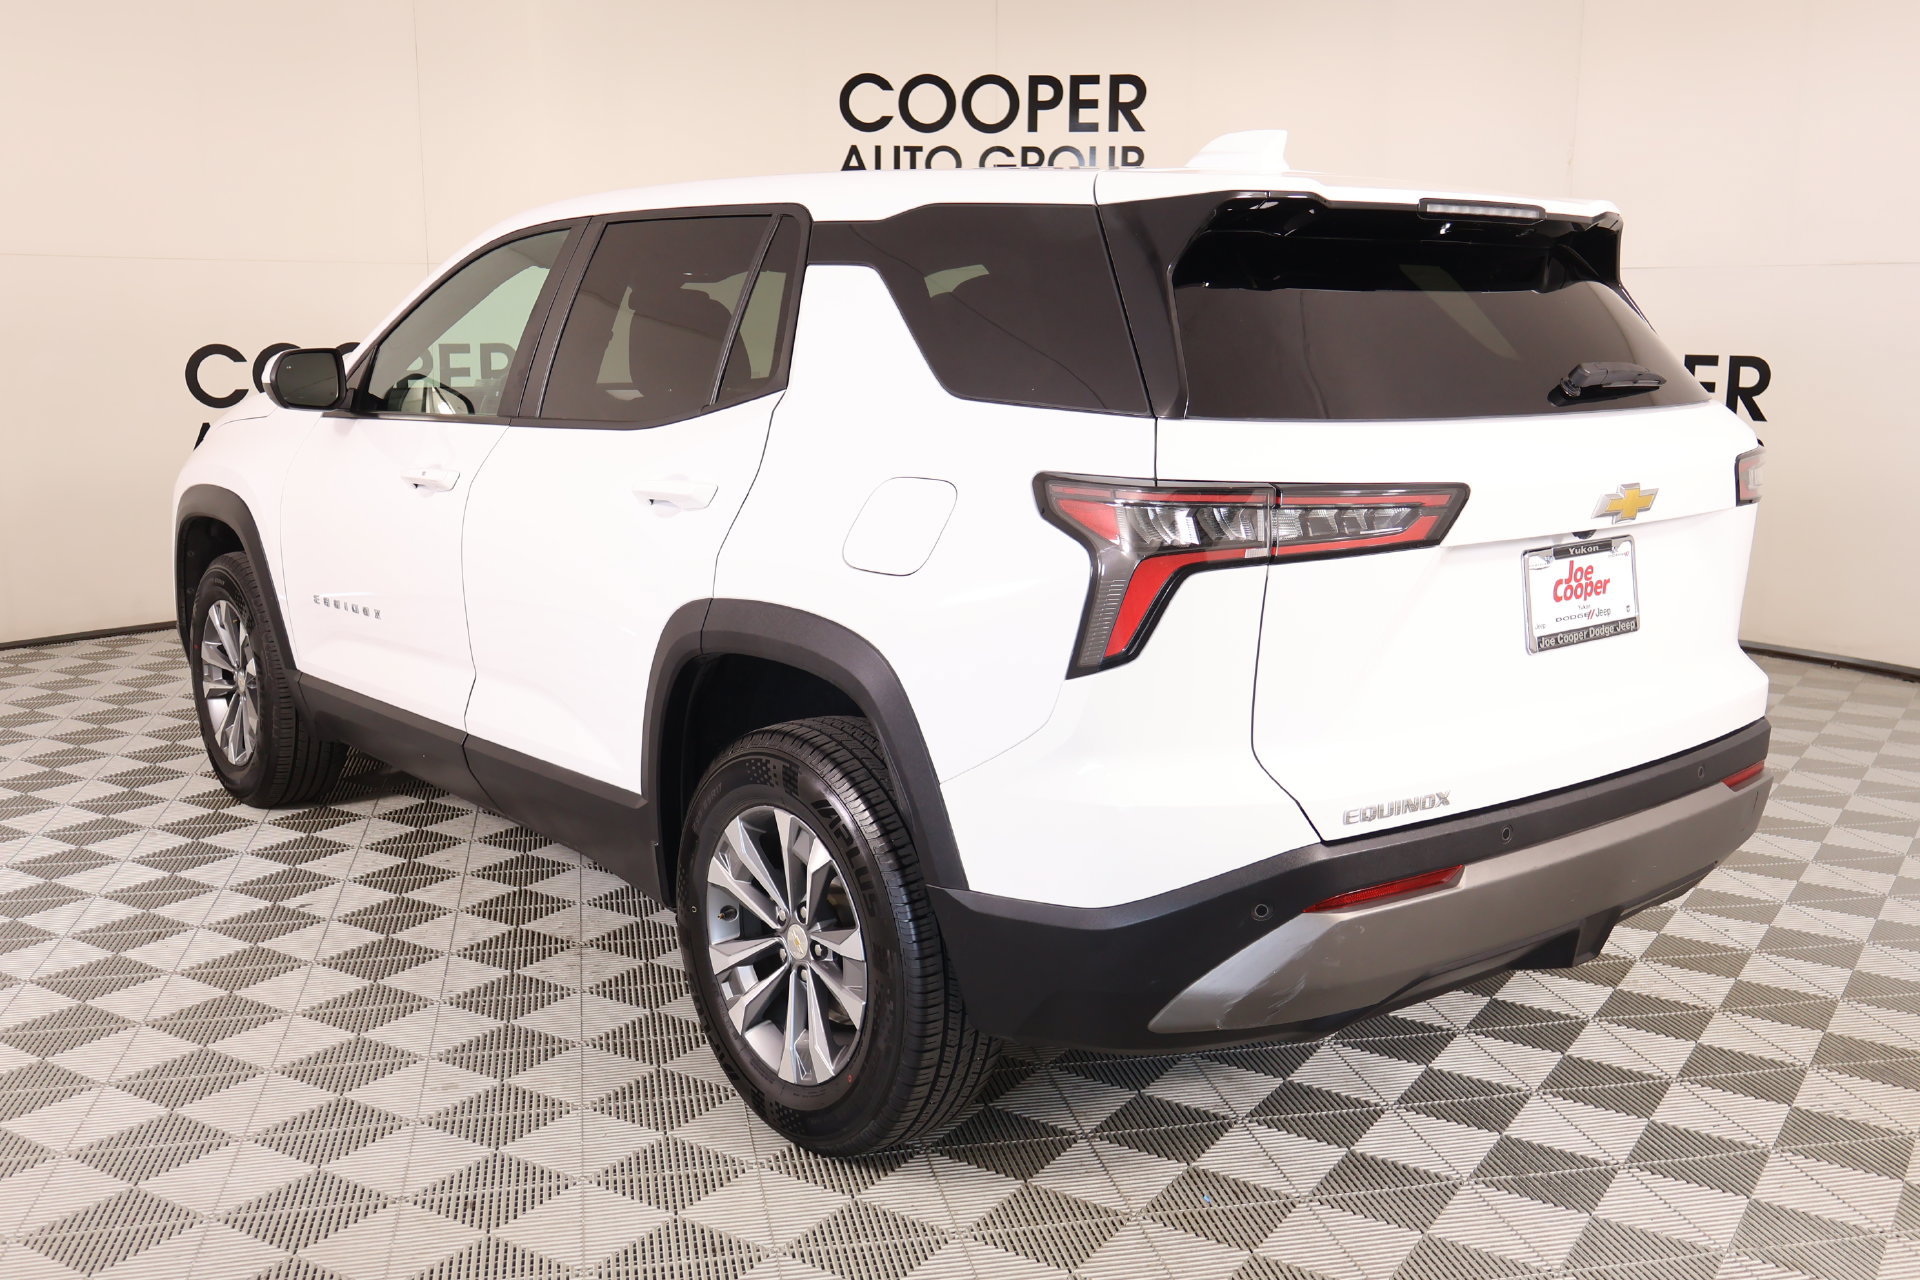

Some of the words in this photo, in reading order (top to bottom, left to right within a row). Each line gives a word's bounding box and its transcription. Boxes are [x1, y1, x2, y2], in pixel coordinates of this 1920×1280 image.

[839, 72, 1147, 134] COOPER
[841, 145, 963, 171] AUTO
[1568, 545, 1600, 556] Yukon
[1565, 560, 1594, 584] Joe
[1553, 578, 1610, 603] Cooper
[313, 594, 382, 620] EQUINOX
[1555, 611, 1590, 622] DODGE
[1595, 607, 1612, 618] Jeep
[1539, 637, 1556, 648] Joe
[1557, 630, 1587, 644] Cooper
[1589, 624, 1615, 637] Dodge
[1616, 620, 1636, 632] Jeep
[1343, 790, 1451, 825] EQUINOX
